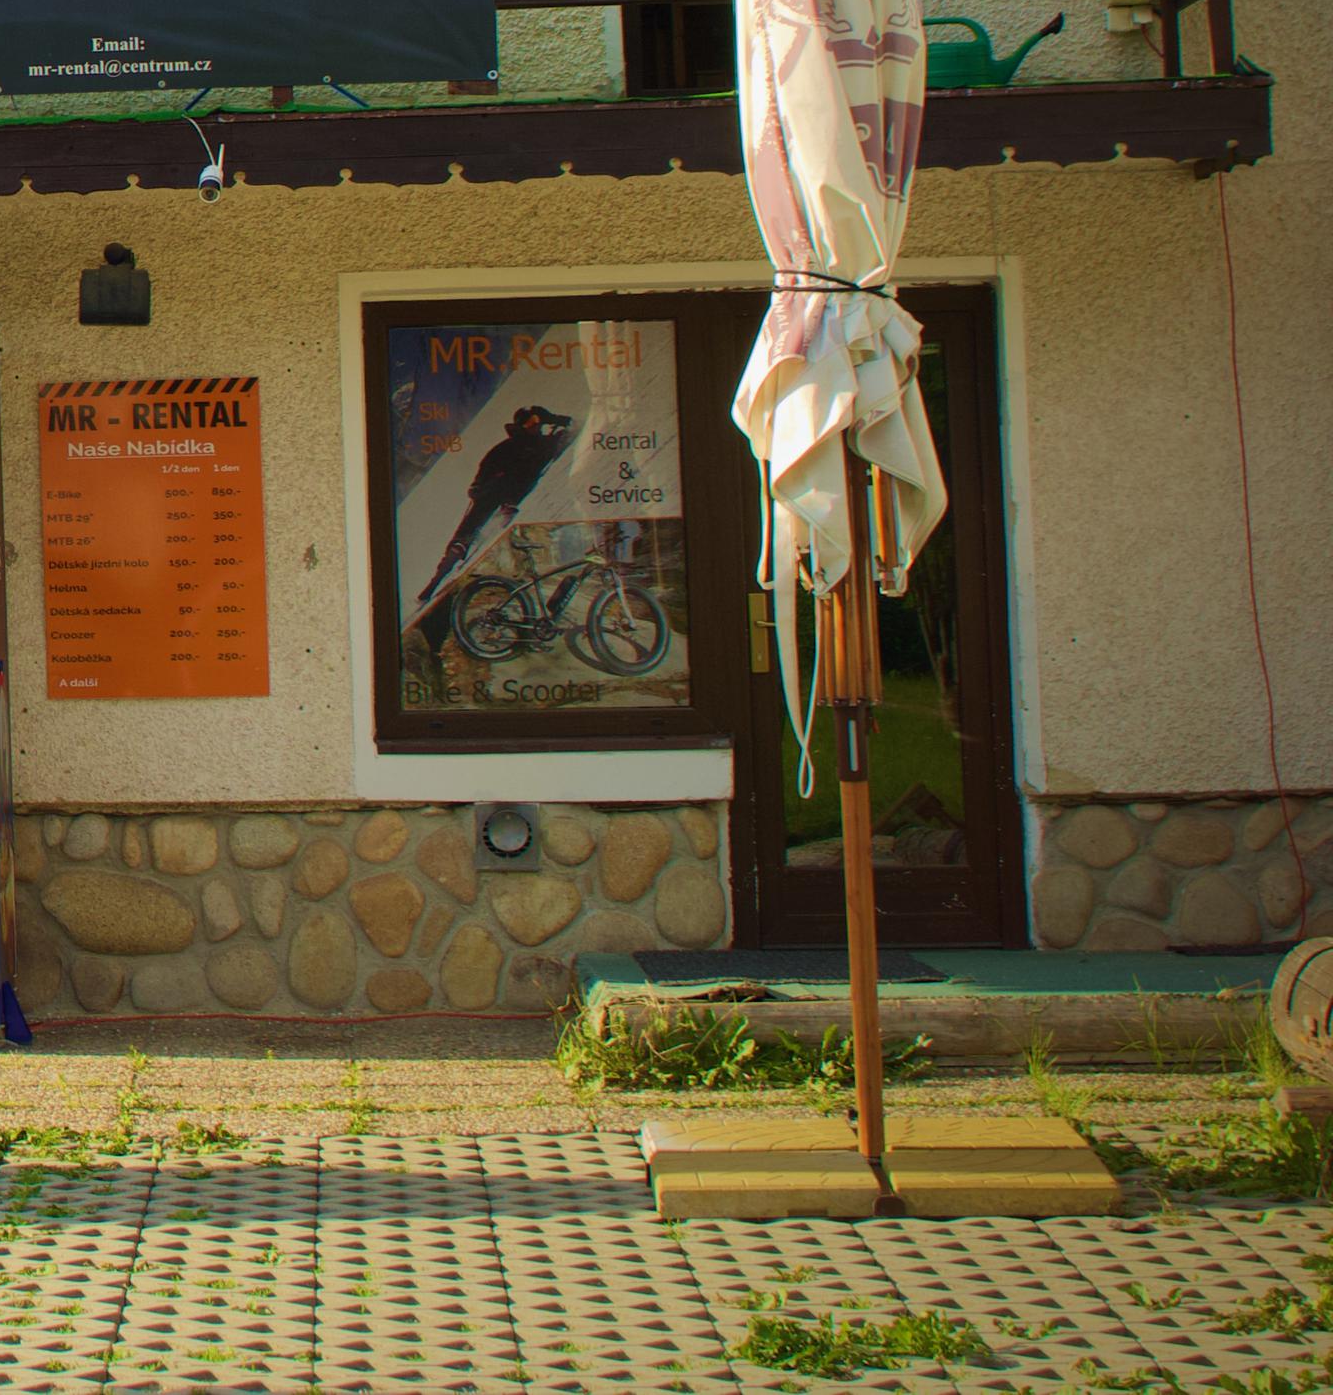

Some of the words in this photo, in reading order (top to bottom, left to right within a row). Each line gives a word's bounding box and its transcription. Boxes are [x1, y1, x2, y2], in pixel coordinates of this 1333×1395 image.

[91, 37, 146, 52] Email:
[28, 58, 212, 78] mr-rental@centrum.cz
[47, 403, 98, 433] MR
[132, 400, 249, 431] RENTAL
[67, 441, 121, 458] Naše
[592, 431, 657, 451] Rental
[618, 461, 637, 480] &
[588, 485, 663, 505] Service
[471, 680, 493, 704] &
[502, 678, 605, 704] Scooter
